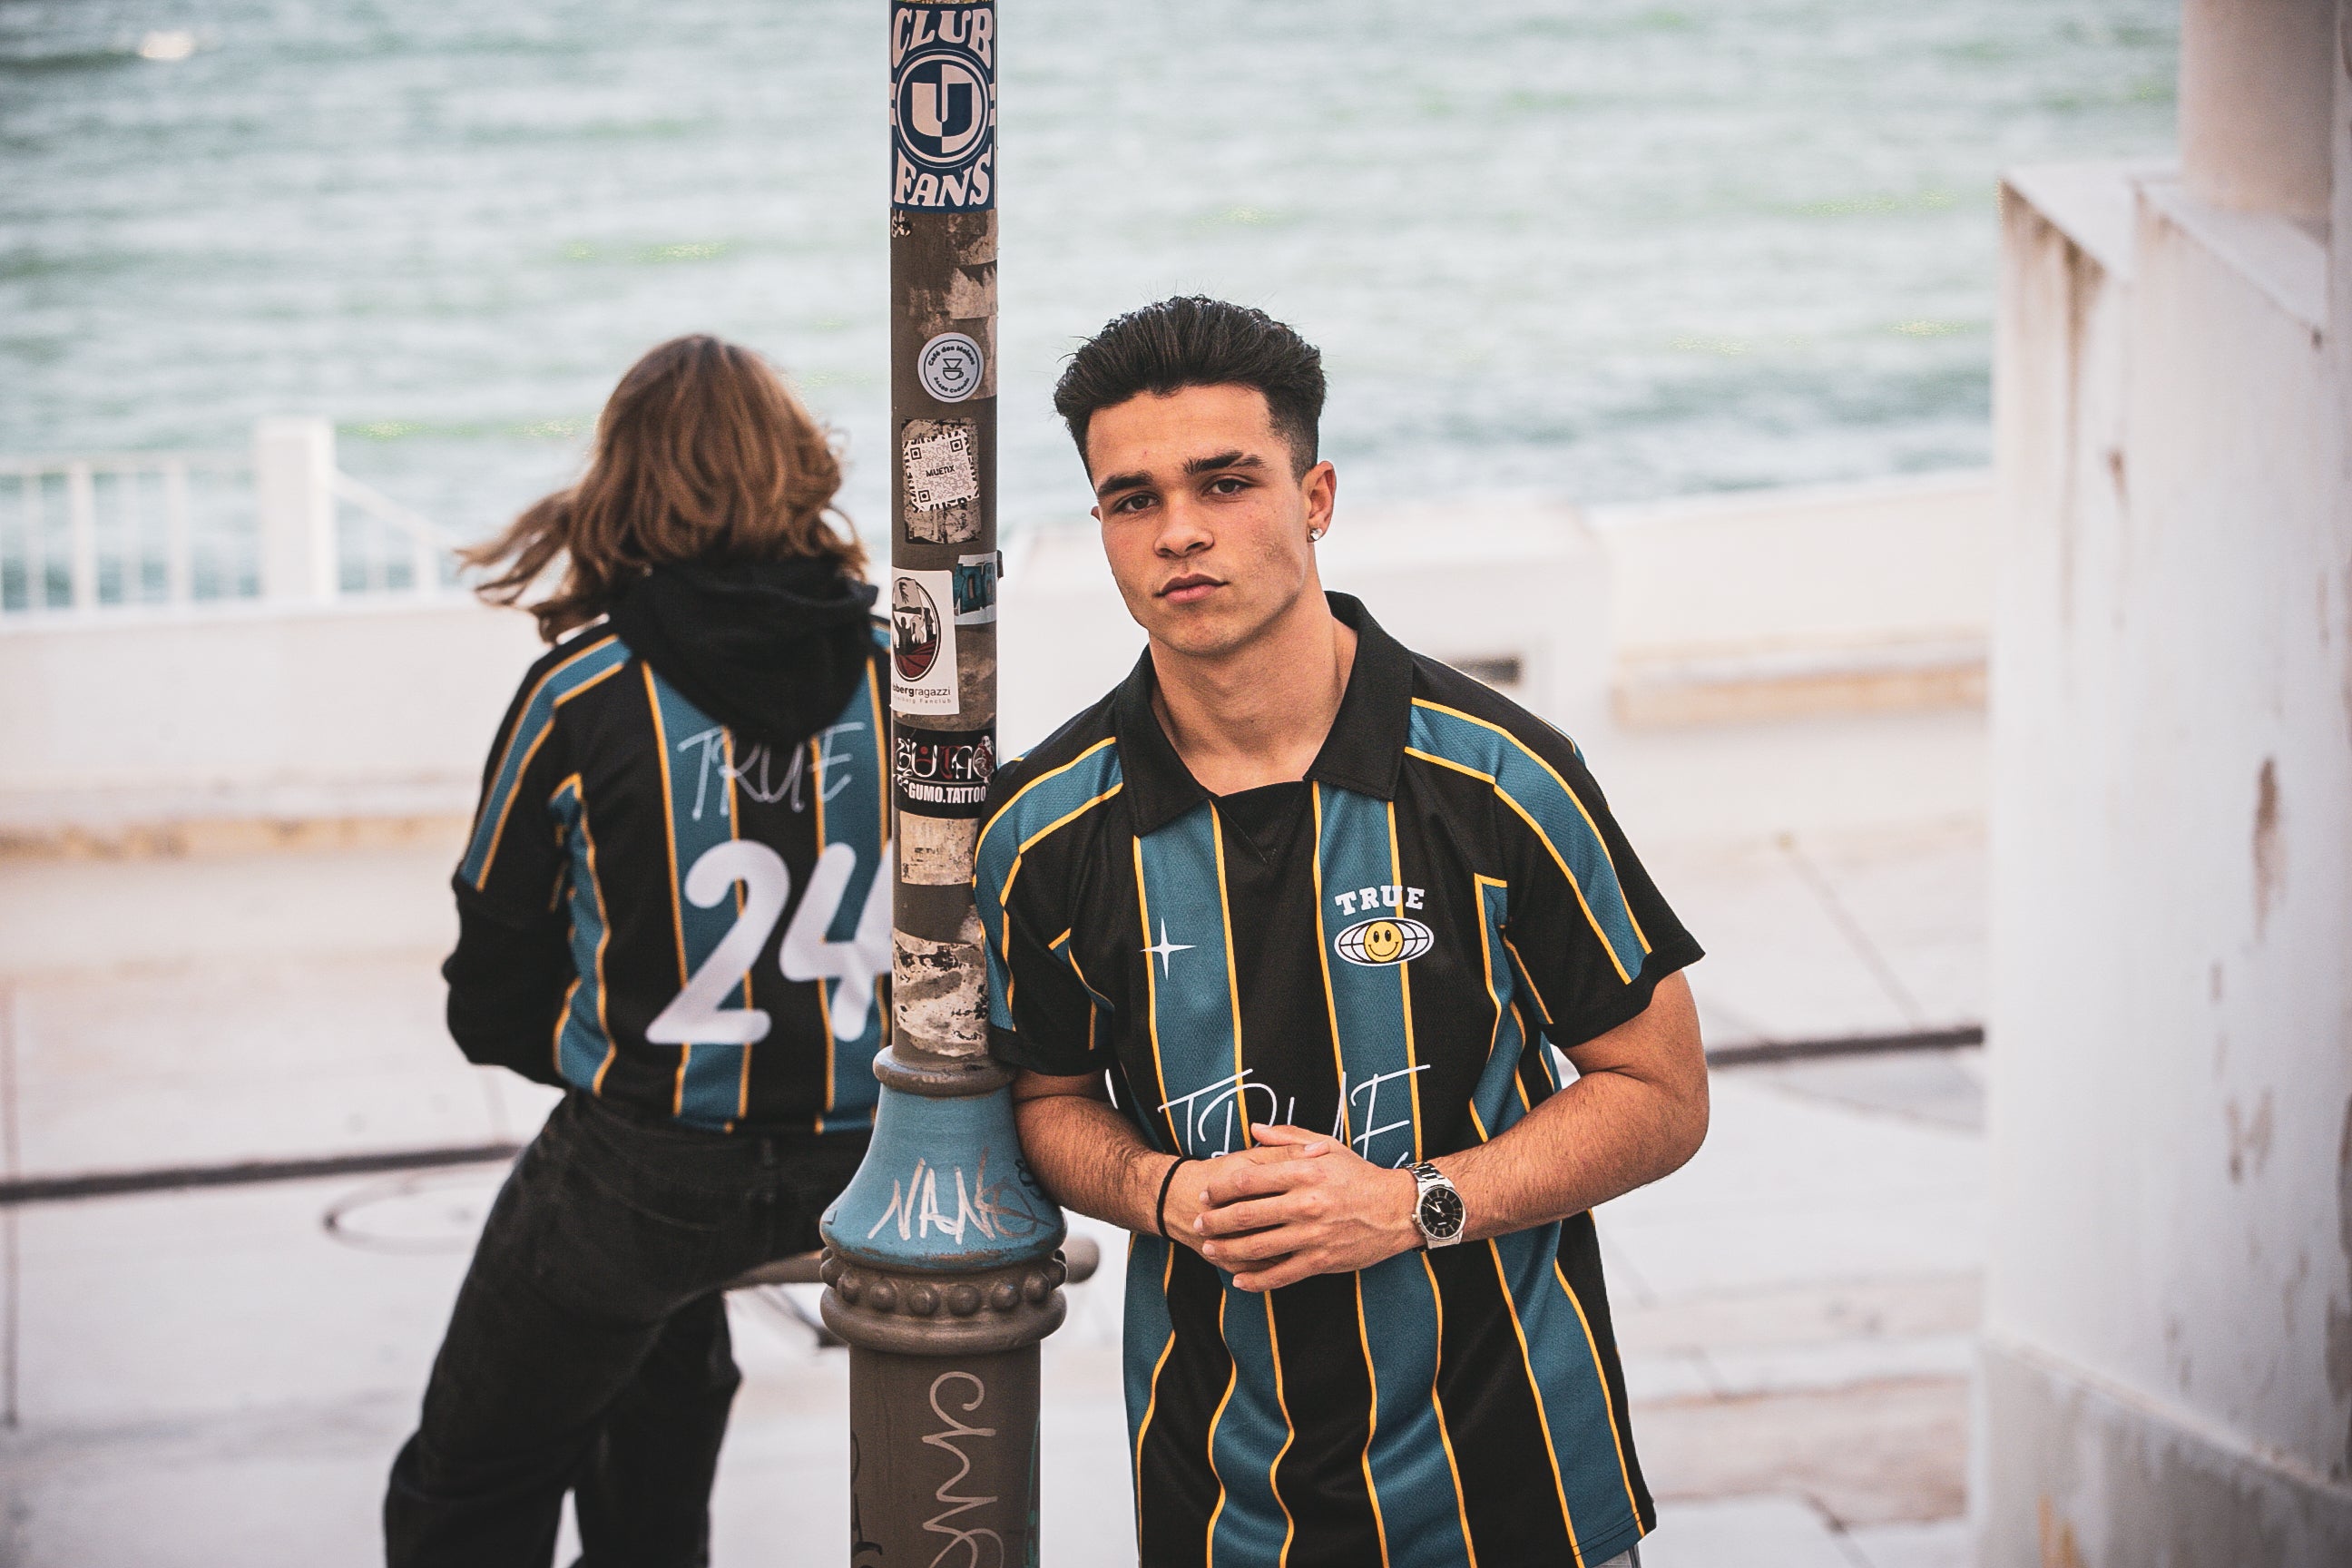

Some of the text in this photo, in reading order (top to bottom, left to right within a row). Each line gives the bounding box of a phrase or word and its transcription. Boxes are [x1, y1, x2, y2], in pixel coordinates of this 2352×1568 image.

[892, 7, 994, 69] CLUB
[894, 142, 993, 207] FANS
[927, 350, 941, 367] Café
[677, 721, 866, 821] TRUE
[908, 782, 986, 804] GUMO.TATTOO
[1334, 885, 1426, 916] TRUE
[644, 838, 893, 1044] 24
